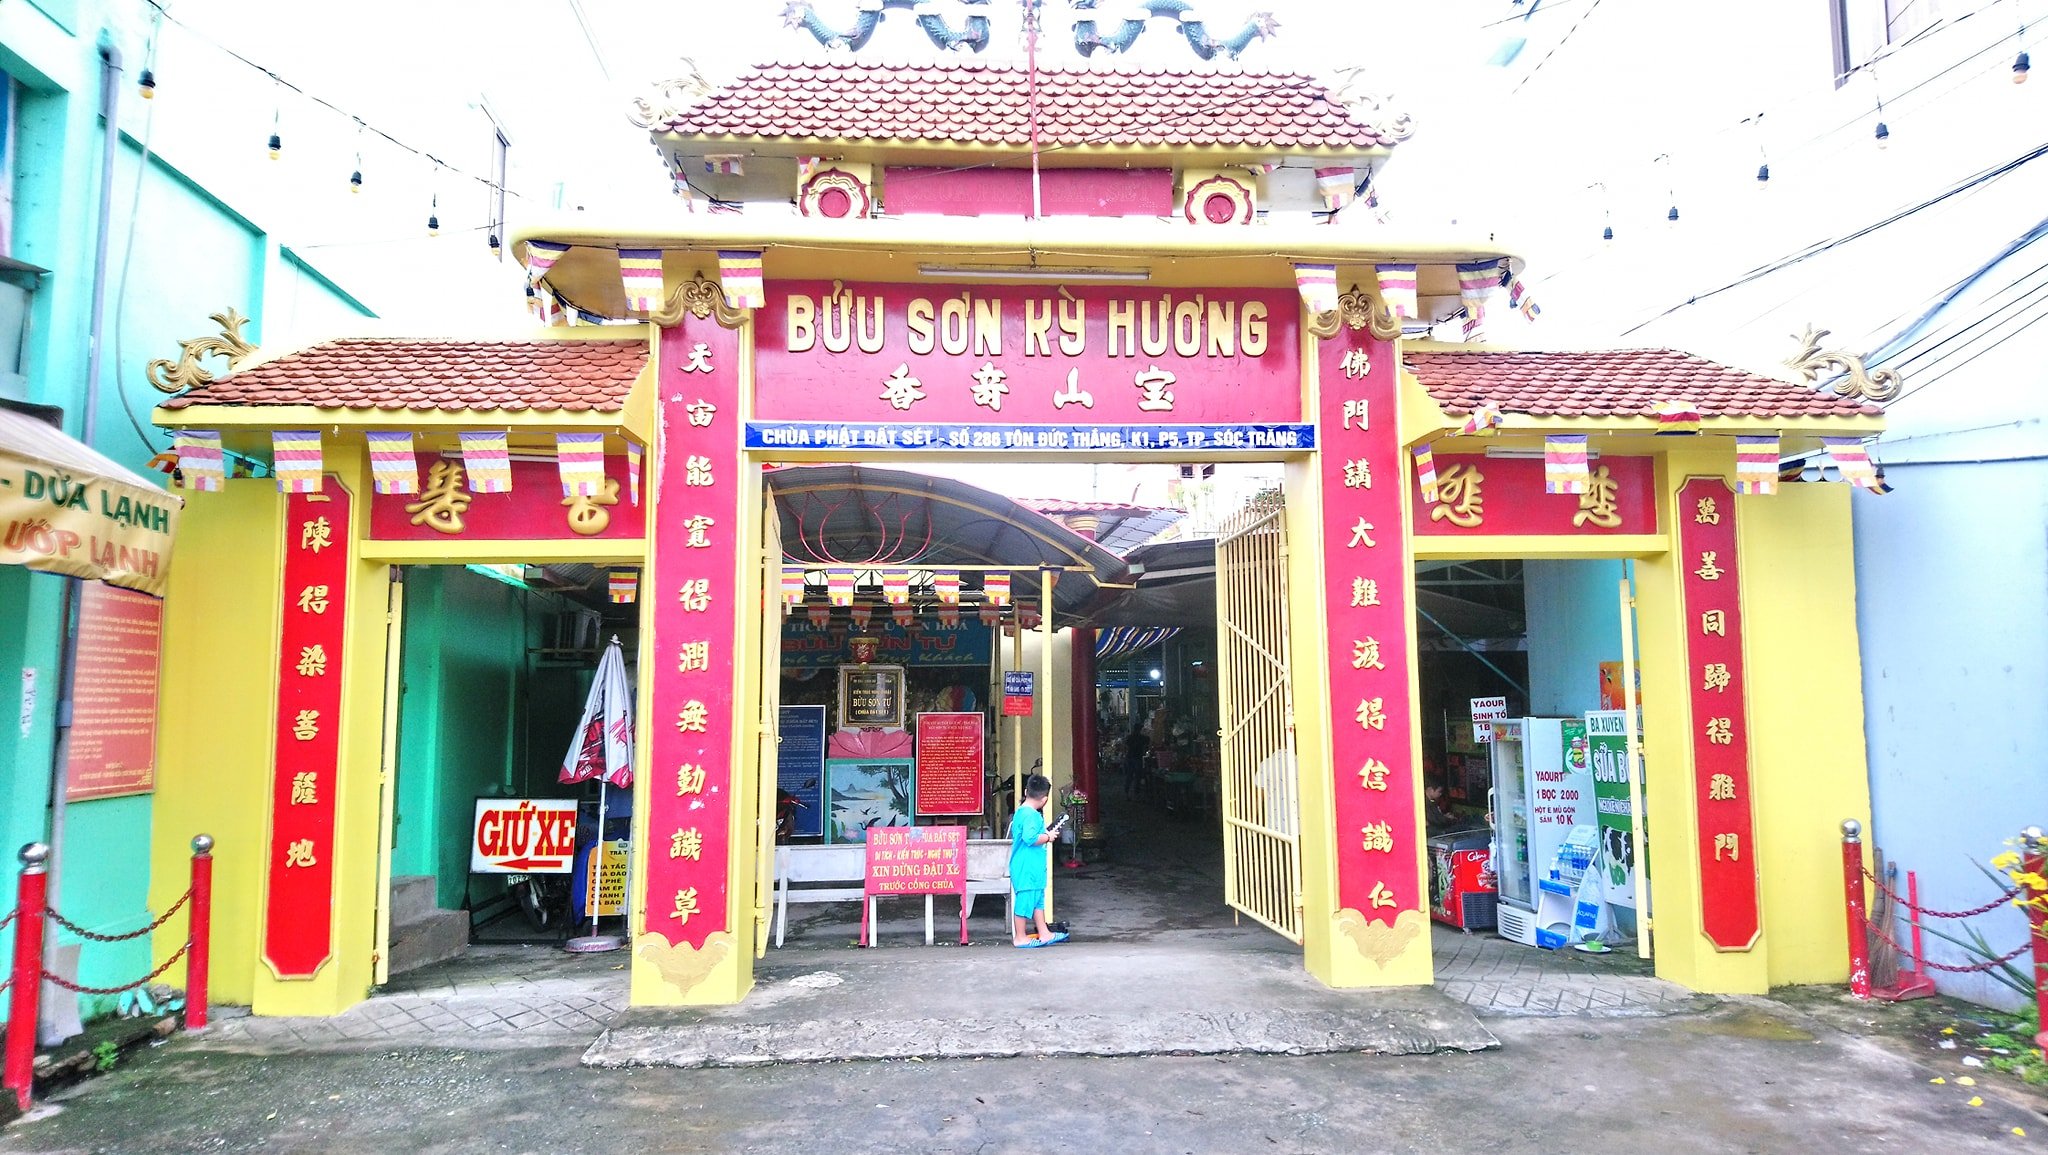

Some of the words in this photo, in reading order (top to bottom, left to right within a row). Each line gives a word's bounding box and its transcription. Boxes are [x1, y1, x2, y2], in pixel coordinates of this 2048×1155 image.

[787, 279, 886, 354] BỬU
[906, 291, 1003, 356] SƠN
[1024, 285, 1086, 357] KỲ
[1107, 293, 1269, 358] HƯƠNG
[762, 427, 811, 446] CHÙA
[814, 424, 860, 448] PHẬT
[863, 424, 898, 446] ĐẤT
[902, 426, 933, 446] SÉT
[949, 426, 970, 447] SỐ
[973, 431, 1001, 447] 286
[1004, 429, 1034, 447] TÔN
[1038, 428, 1068, 448] ĐỨC
[1131, 431, 1155, 449] K1,
[1159, 431, 1183, 448] P5,
[1213, 427, 1244, 447] SÓC
[1247, 428, 1298, 447] TRĂNG
[24, 468, 90, 512] DỪA
[101, 489, 170, 534] LẠNH
[90, 535, 160, 579] LẠNH
[1473, 712, 1494, 720] SINH
[1590, 717, 1600, 733] BA
[1593, 741, 1618, 784] SỮA
[1535, 770, 1565, 782] YAOURT
[1541, 788, 1557, 801] BỌC
[1556, 814, 1565, 825] 10
[1566, 814, 1573, 825] K
[478, 800, 537, 857] GIỮ
[534, 810, 577, 856] XE
[872, 864, 891, 877] XIN
[893, 861, 921, 877] ĐỪNG
[923, 861, 944, 877] ĐẬU
[932, 878, 954, 889] CHÙA
